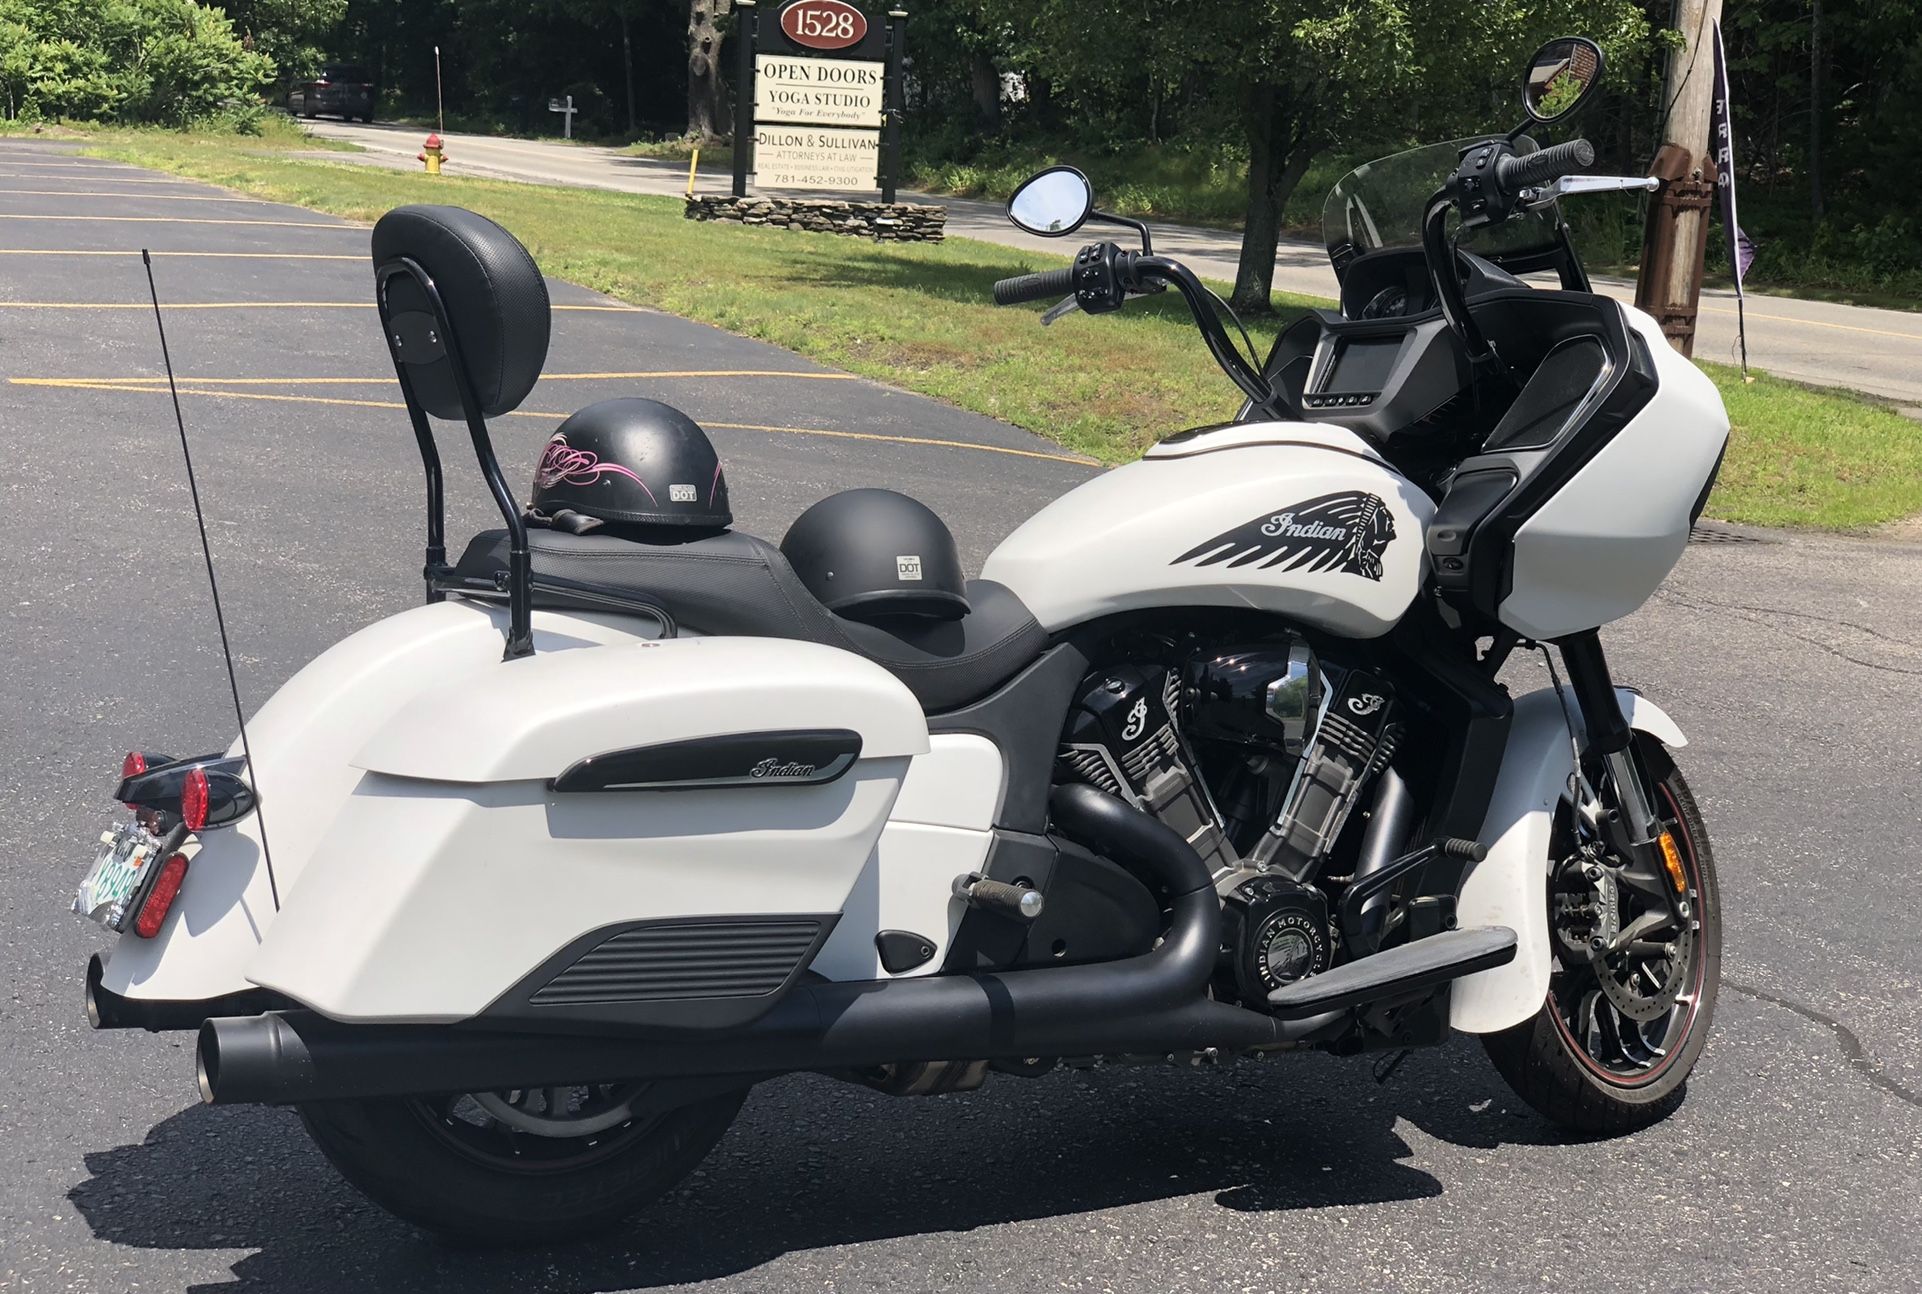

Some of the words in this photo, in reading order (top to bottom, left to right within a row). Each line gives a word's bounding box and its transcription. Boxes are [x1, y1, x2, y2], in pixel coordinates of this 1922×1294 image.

[796, 9, 854, 38] 1528
[764, 63, 811, 81] OPEN
[817, 67, 877, 85] DOORS
[769, 90, 810, 105] YOGA
[814, 93, 871, 108] STUDIO
[799, 108, 813, 116] For
[759, 132, 803, 147] DILLON
[807, 134, 815, 148] &
[818, 135, 876, 150] SULLIVAN
[776, 150, 827, 161] ATTORNEYS
[828, 152, 838, 160] AT
[839, 153, 858, 162] LAW
[774, 174, 858, 186] 781-452-9300
[673, 491, 694, 500] DOT
[1260, 512, 1347, 542] Indian
[899, 563, 919, 573] DOT
[750, 757, 815, 778] Indian
[1258, 927, 1276, 981] INDIAN
